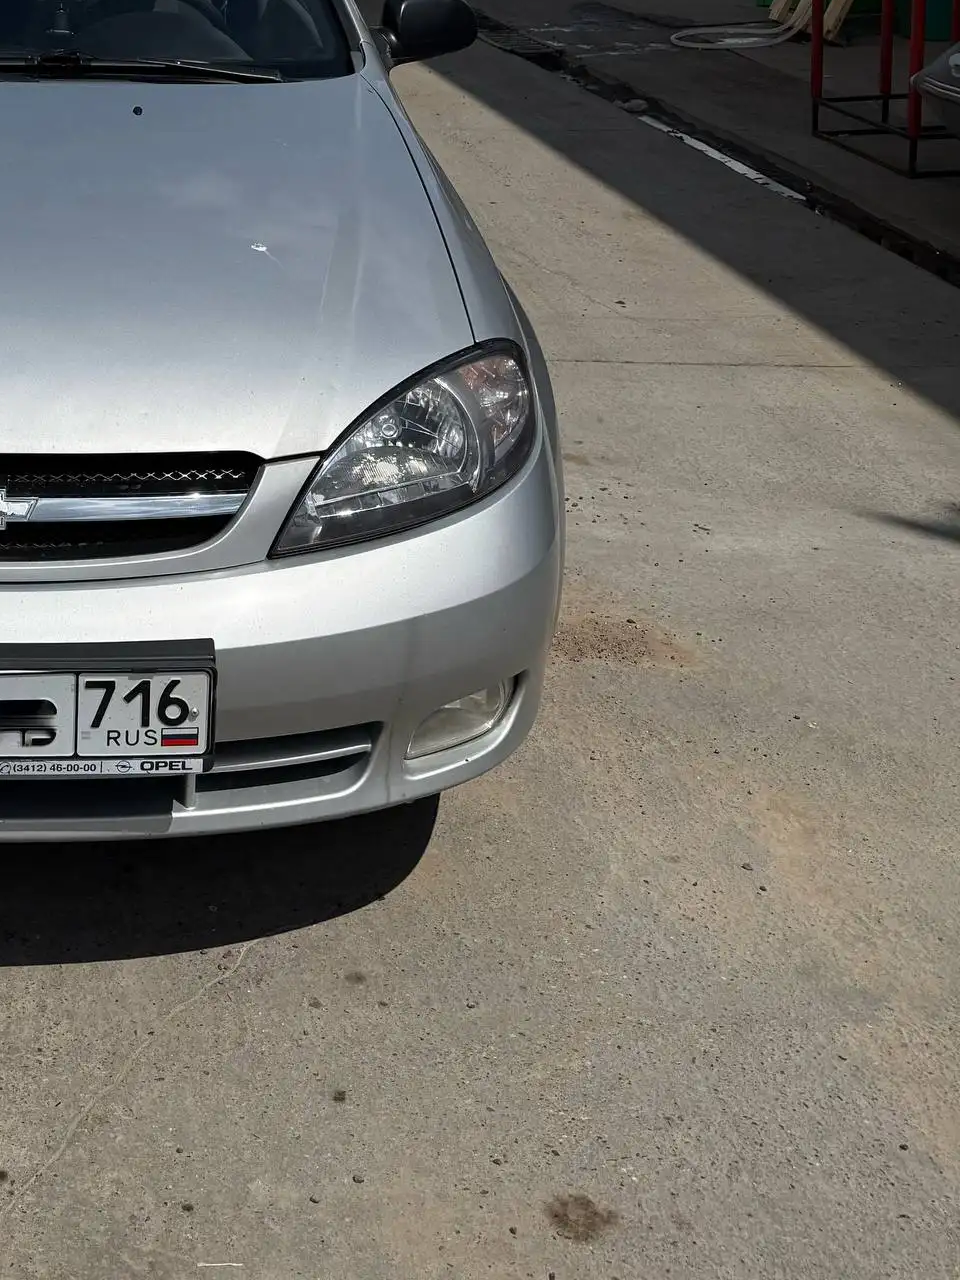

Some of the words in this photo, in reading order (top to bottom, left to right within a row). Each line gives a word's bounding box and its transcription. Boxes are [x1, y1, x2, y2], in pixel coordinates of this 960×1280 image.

[84, 679, 189, 729] 716
[106, 729, 158, 746] RUS
[13, 763, 46, 773] (3412)
[50, 764, 96, 772] 46-00-00
[140, 761, 193, 771] OPEL
